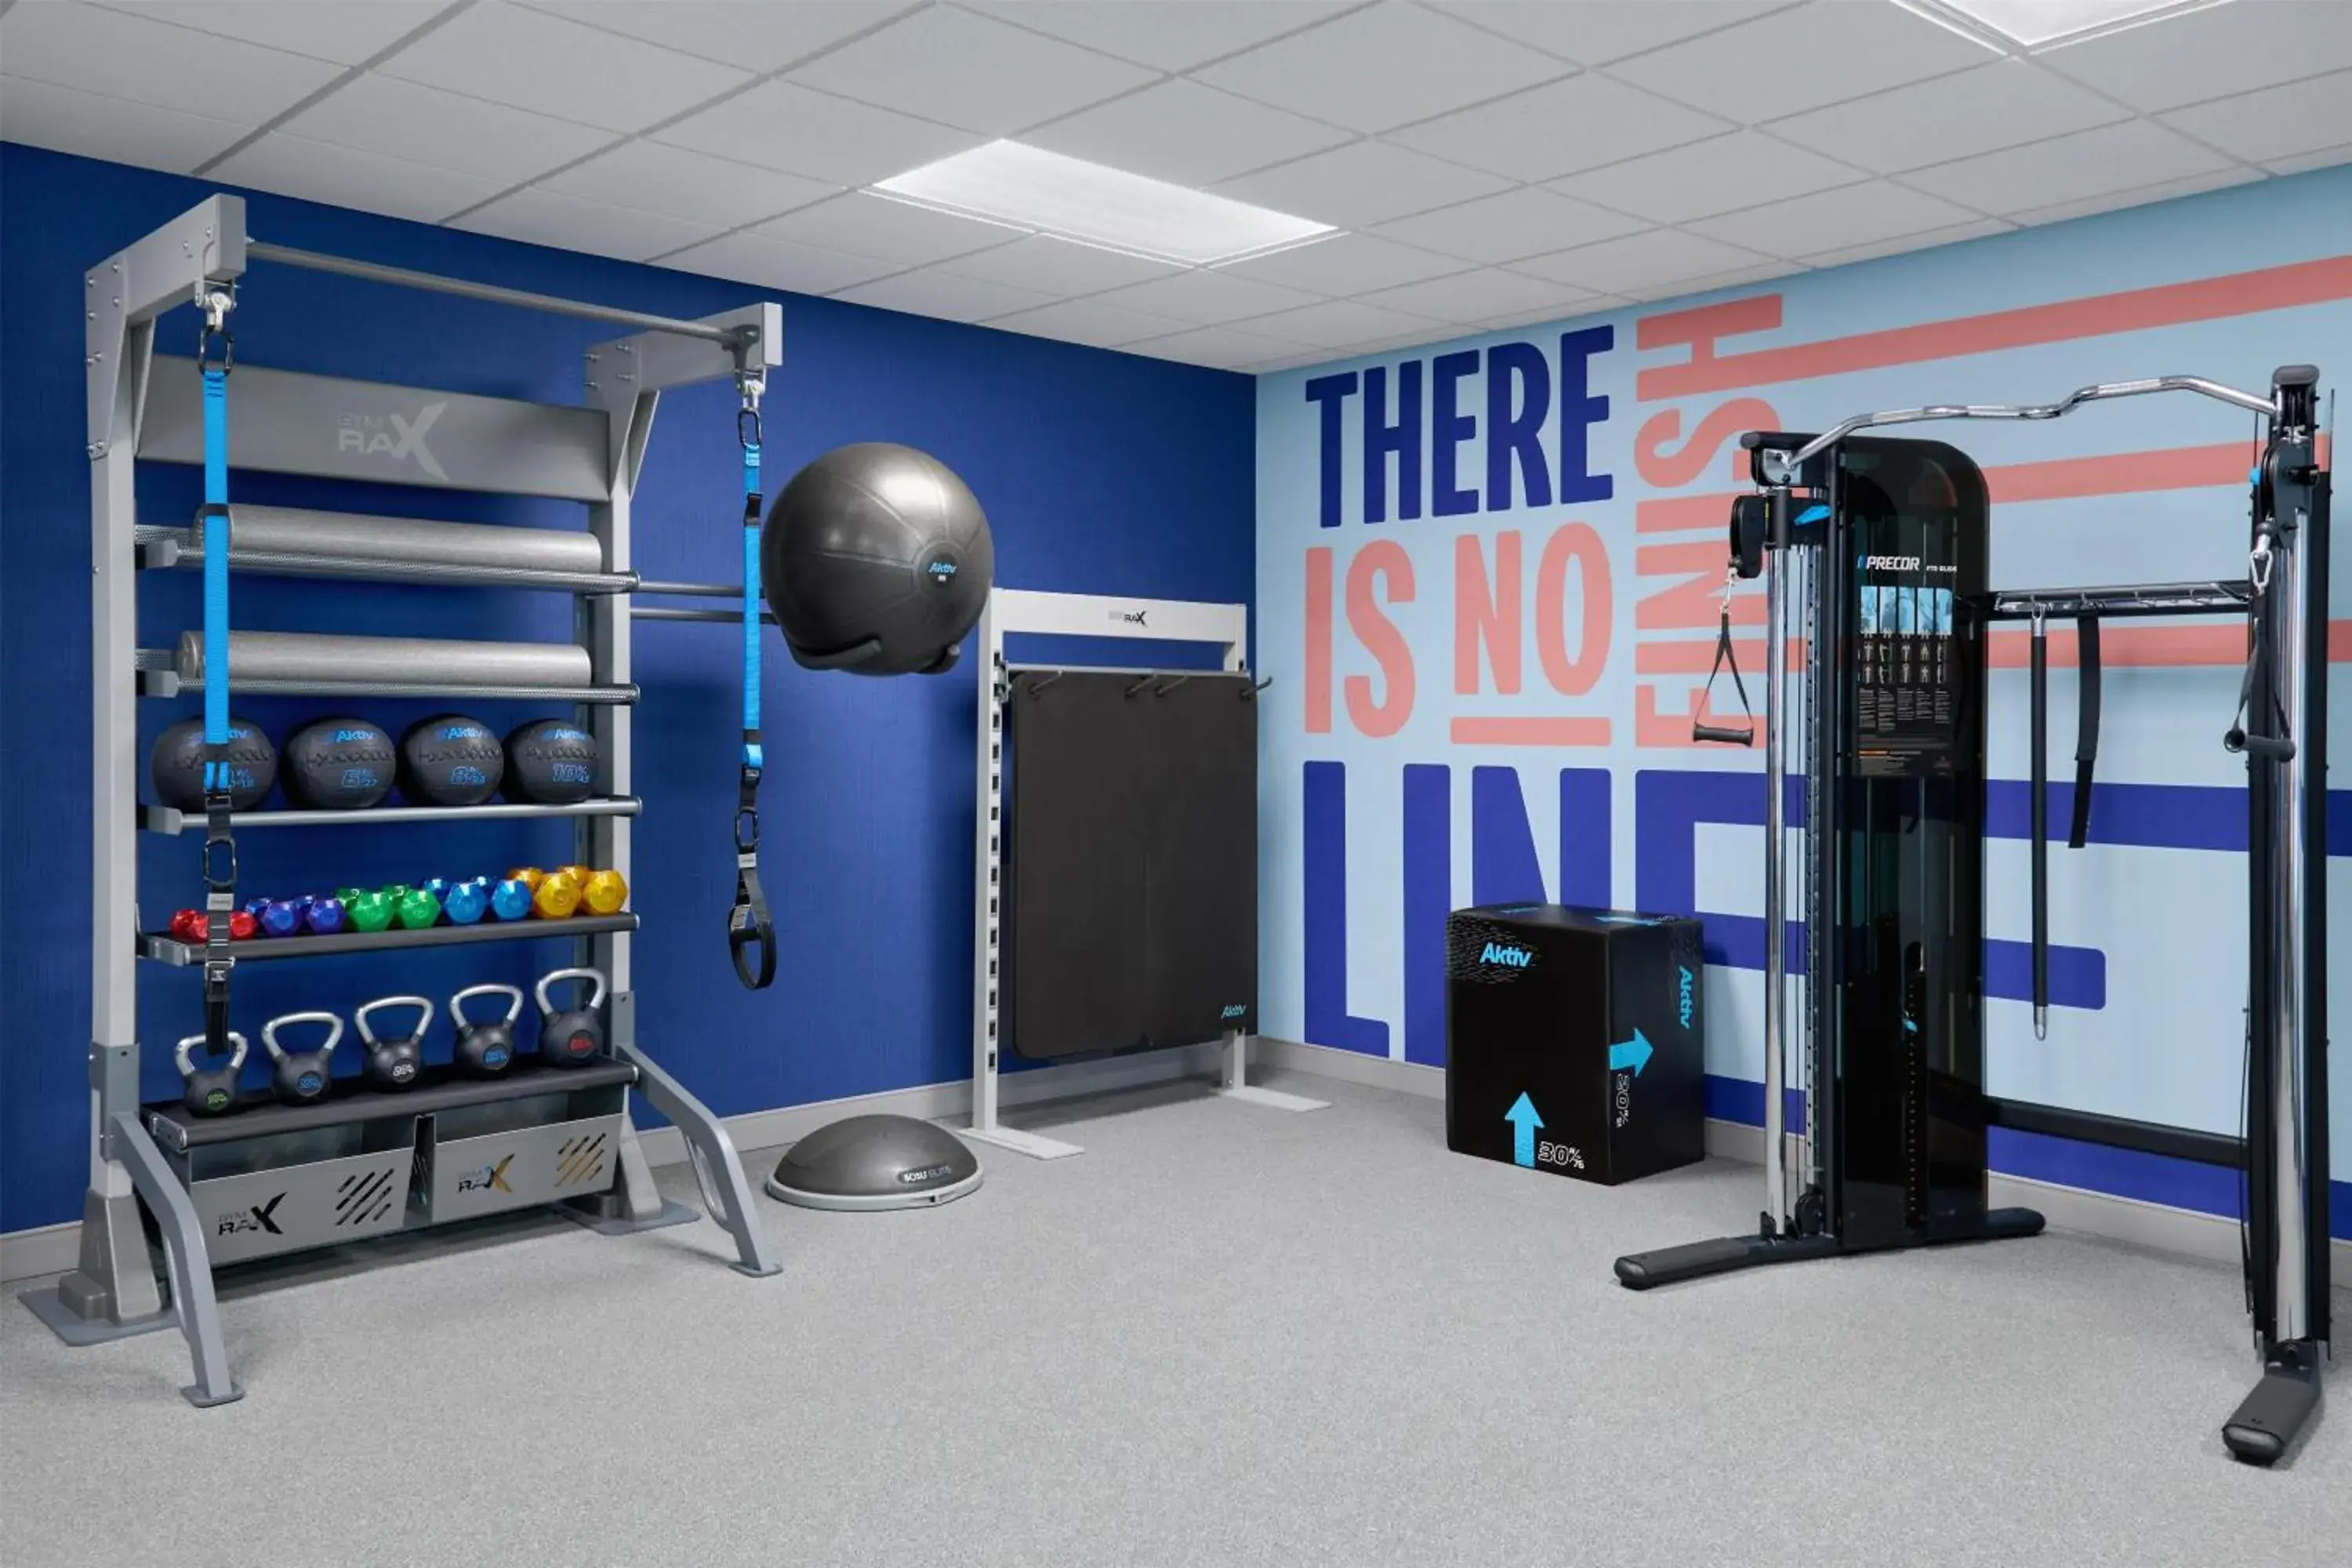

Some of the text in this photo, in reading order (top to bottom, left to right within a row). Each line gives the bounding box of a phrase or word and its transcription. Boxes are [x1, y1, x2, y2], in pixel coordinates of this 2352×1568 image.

[1305, 324, 1613, 528] THERE
[1633, 293, 1783, 749] FINISH
[1865, 556, 1920, 571] PRECOR
[1305, 521, 1613, 739] IS NO
[1479, 942, 1531, 967] Aktiv
[1679, 965, 1693, 1029] Aktiv
